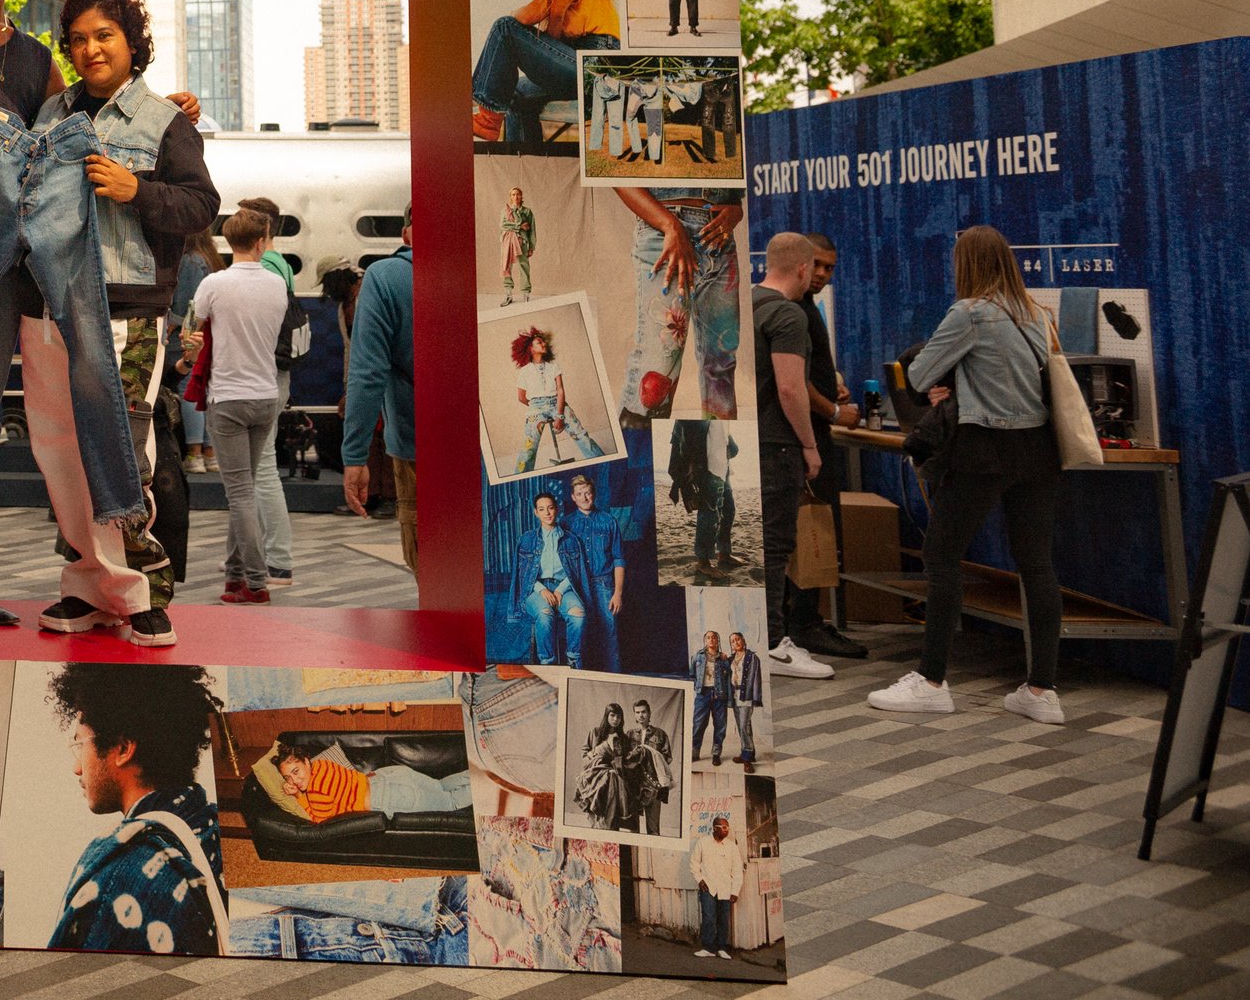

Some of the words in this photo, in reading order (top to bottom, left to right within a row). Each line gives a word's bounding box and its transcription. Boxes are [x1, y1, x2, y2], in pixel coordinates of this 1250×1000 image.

[753, 160, 799, 196] START
[805, 155, 850, 191] YOUR
[900, 140, 989, 183] JOURNEY
[997, 132, 1060, 175] HERE
[1023, 260, 1042, 272] #4
[1062, 259, 1114, 272] LASER
